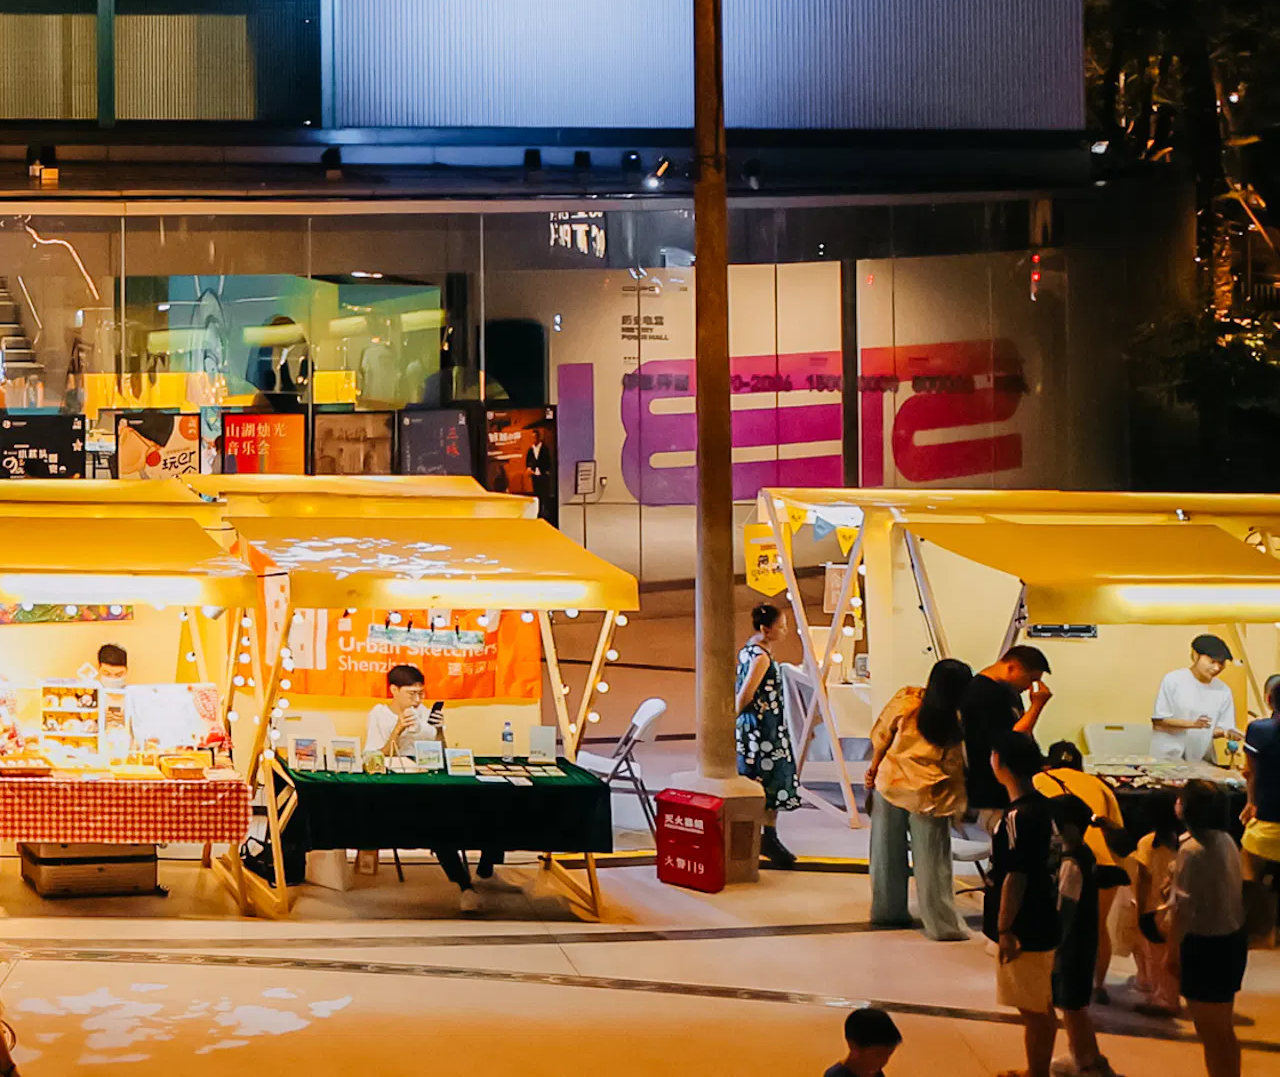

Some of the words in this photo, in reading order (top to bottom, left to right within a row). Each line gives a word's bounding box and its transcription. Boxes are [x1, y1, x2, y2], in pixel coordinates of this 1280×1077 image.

[226, 422, 287, 438] 山湖烛光
[227, 440, 271, 455] 音乐会
[338, 637, 400, 654] Urban
[664, 814, 704, 830] 灭火器箱
[664, 855, 705, 875] 火警119
